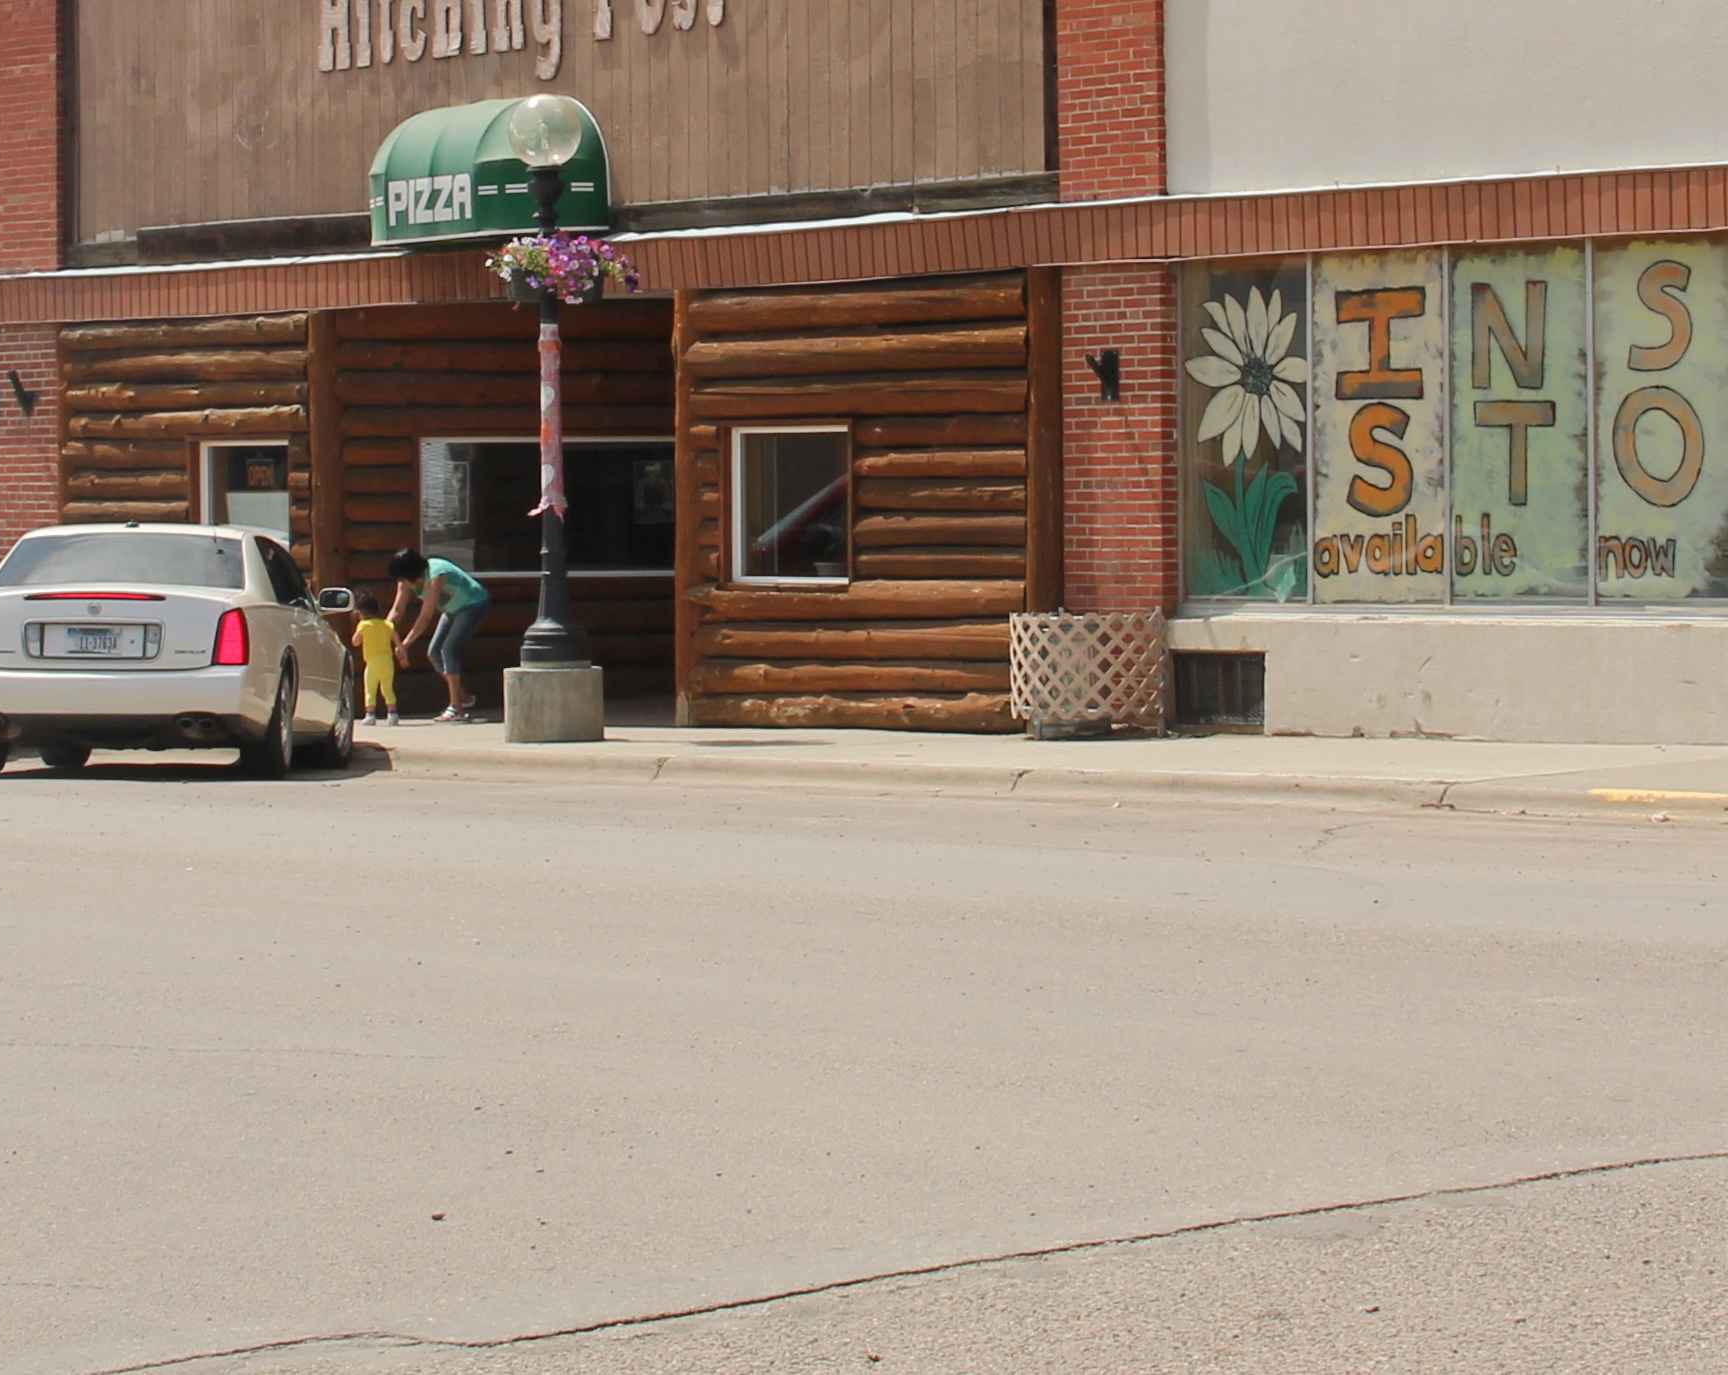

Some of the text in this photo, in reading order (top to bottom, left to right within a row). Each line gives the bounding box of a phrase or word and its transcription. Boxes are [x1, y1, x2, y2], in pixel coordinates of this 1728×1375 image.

[387, 172, 473, 227] PIZZA
[1313, 512, 1677, 580] available now
